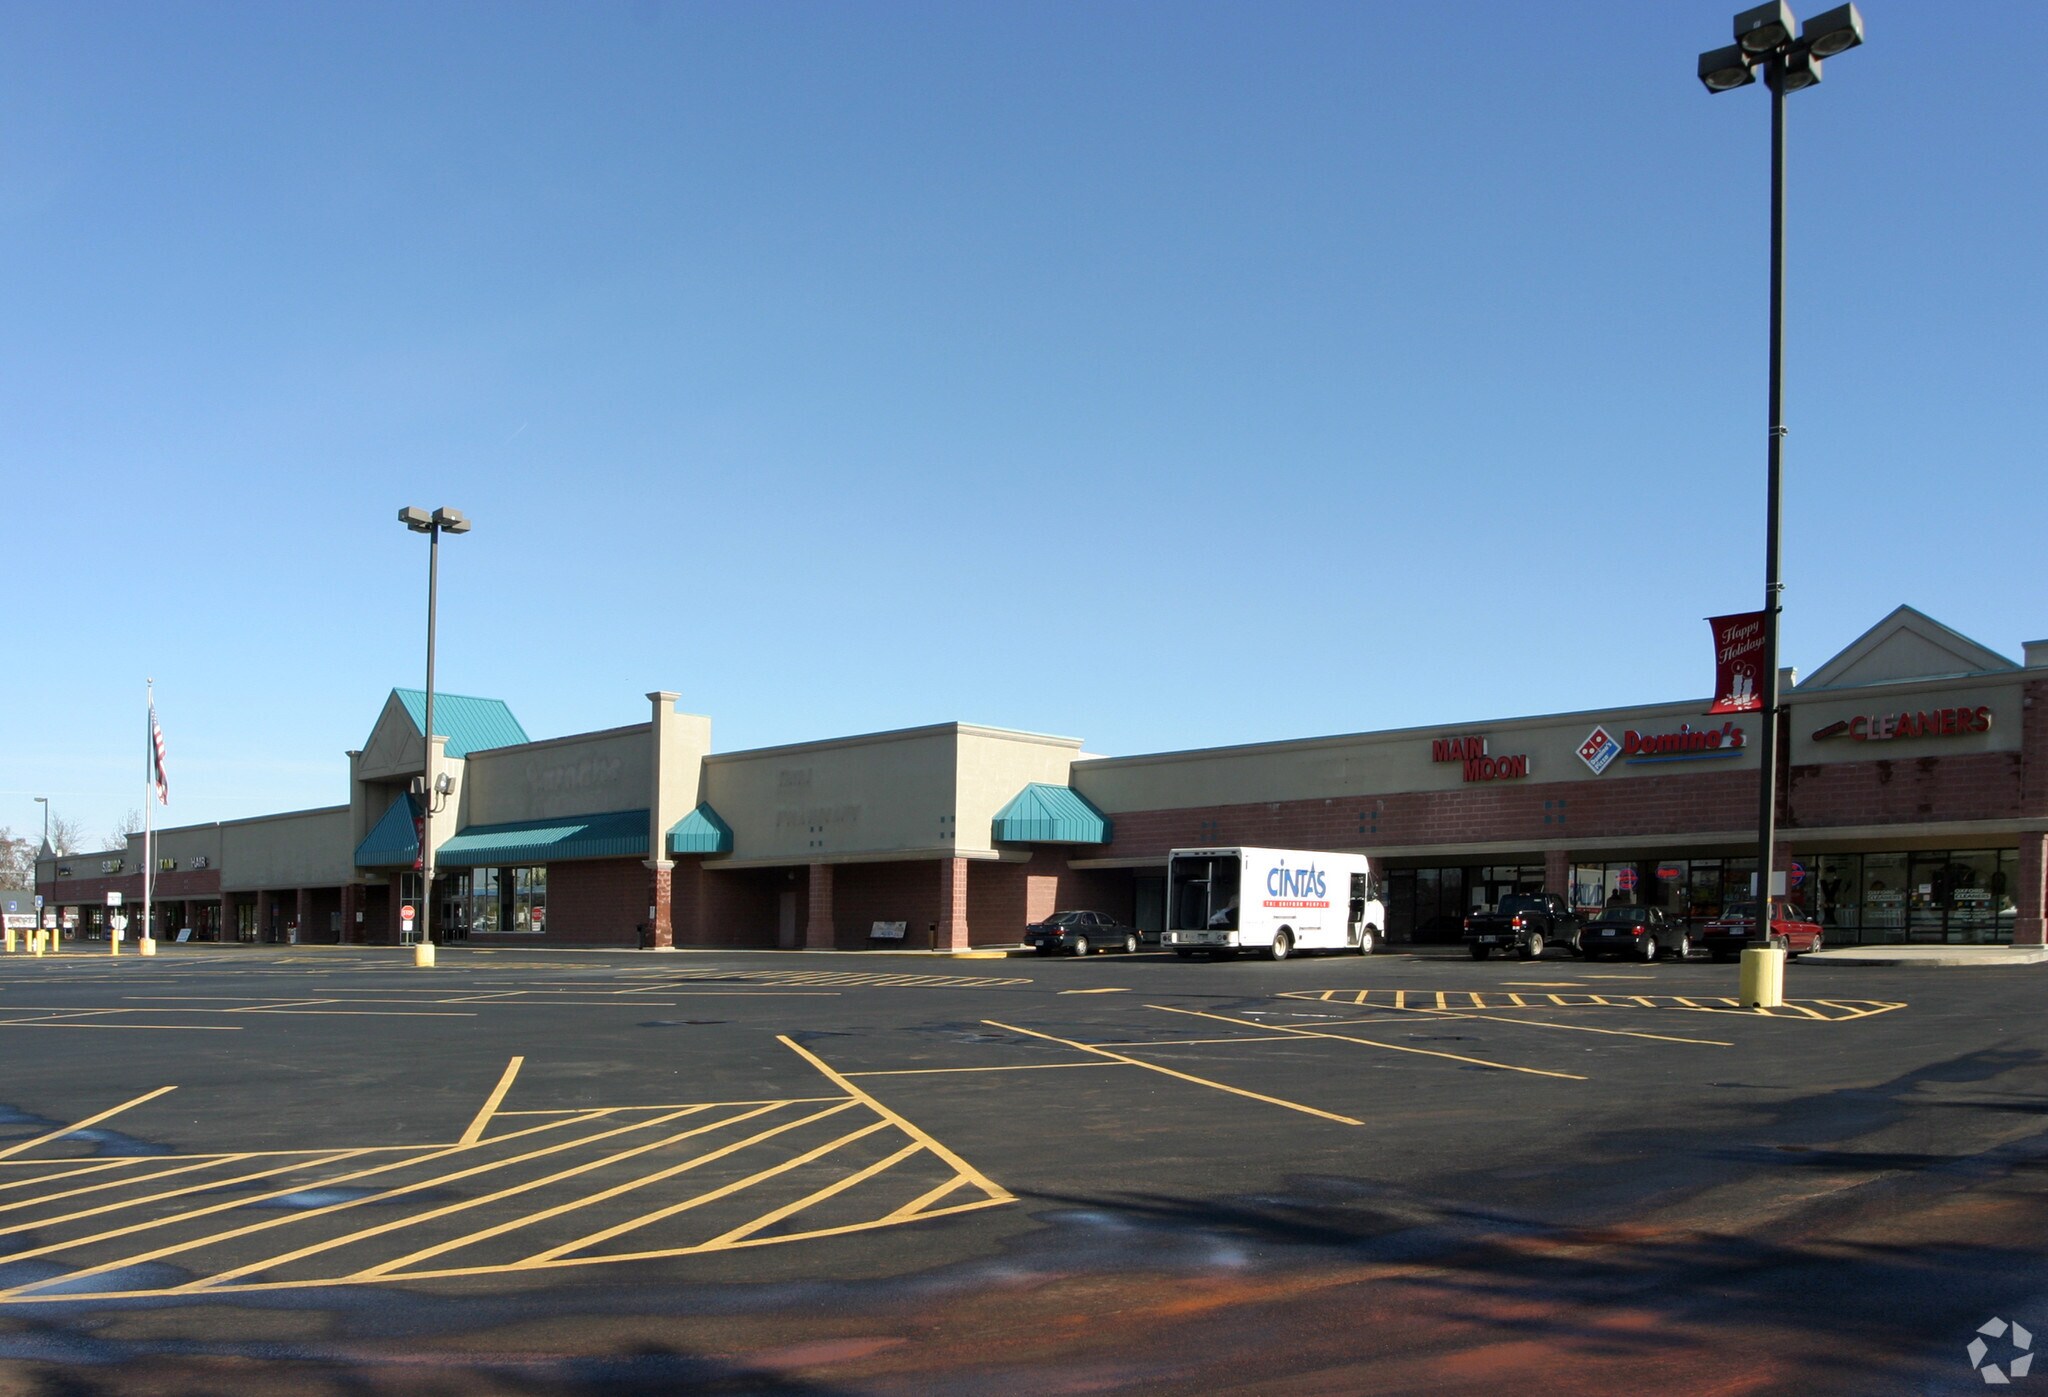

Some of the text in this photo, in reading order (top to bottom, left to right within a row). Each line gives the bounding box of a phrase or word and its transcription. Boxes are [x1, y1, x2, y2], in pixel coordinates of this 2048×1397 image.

[1722, 621, 1759, 645] Happy
[1719, 636, 1765, 665] Holidays
[1625, 722, 1745, 754] Domino's
[1849, 706, 1992, 742] CLEANERS
[1432, 736, 1485, 762] MAIN
[1463, 755, 1528, 782] MOON
[1266, 858, 1327, 899] CINTAS
